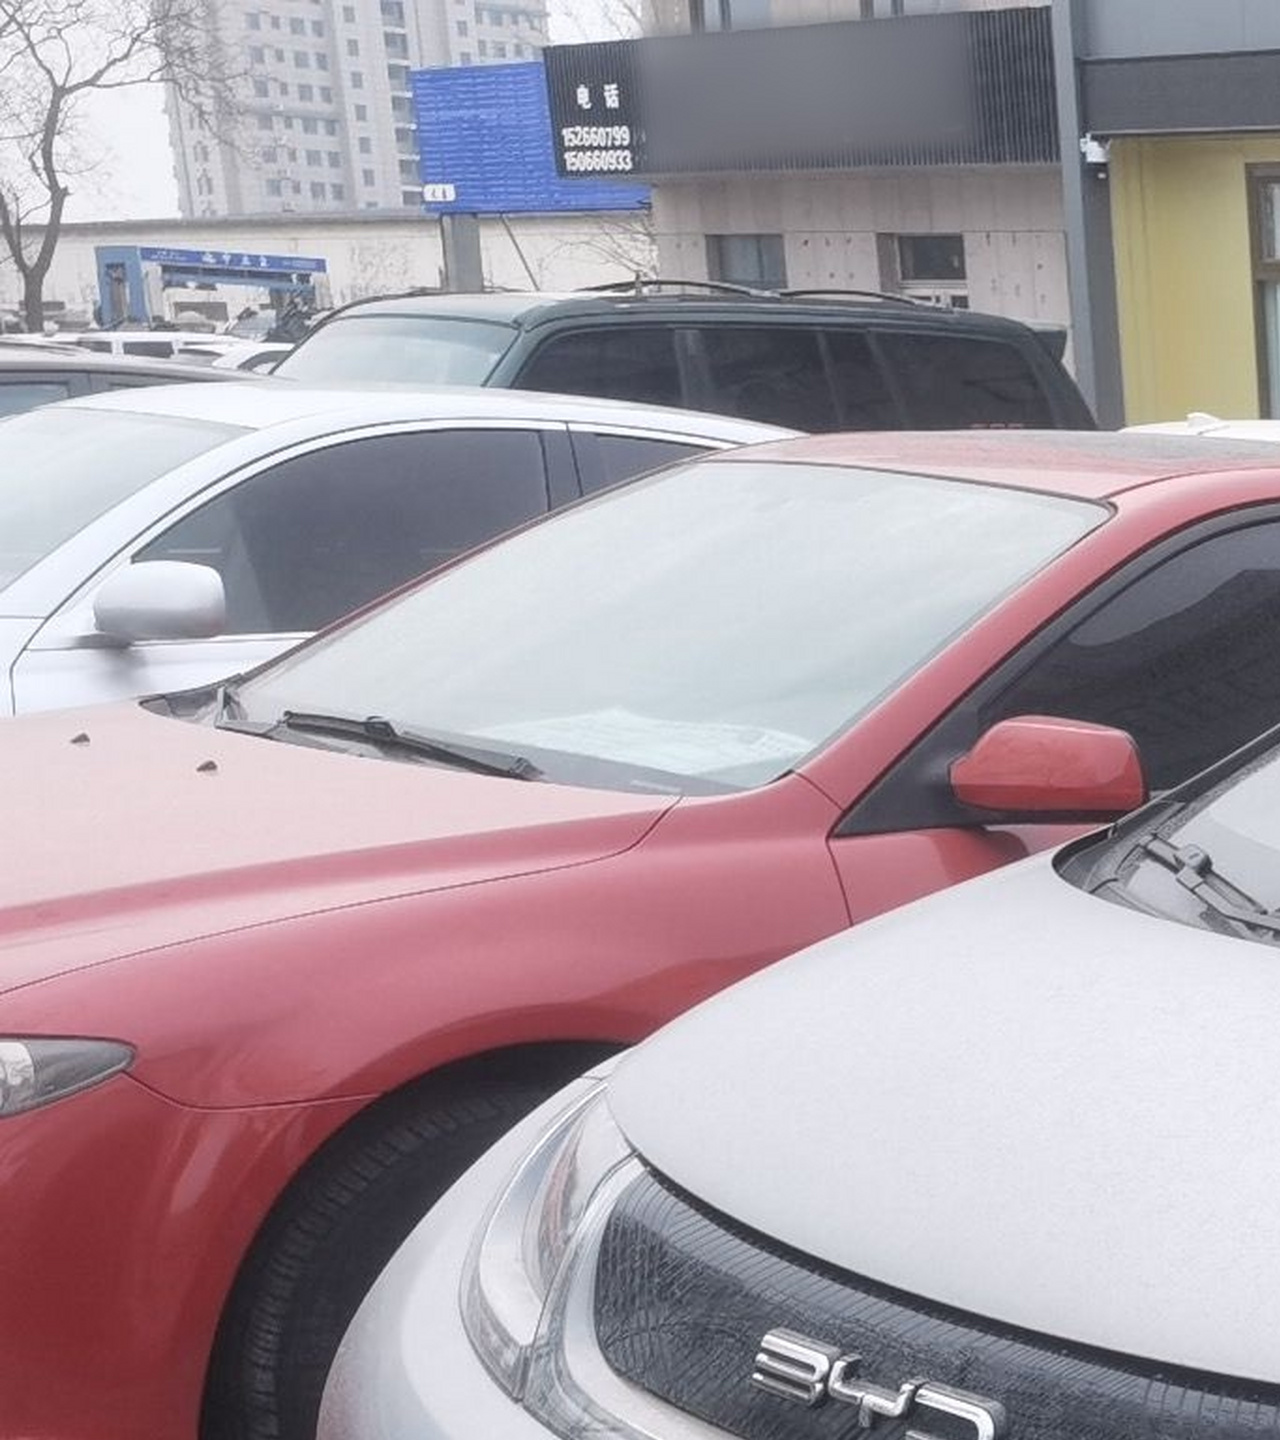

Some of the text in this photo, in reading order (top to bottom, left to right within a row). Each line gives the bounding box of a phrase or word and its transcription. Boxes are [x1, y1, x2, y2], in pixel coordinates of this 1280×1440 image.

[576, 83, 620, 109] 电话
[562, 125, 646, 147] 152660799
[564, 149, 647, 172] 150660933
